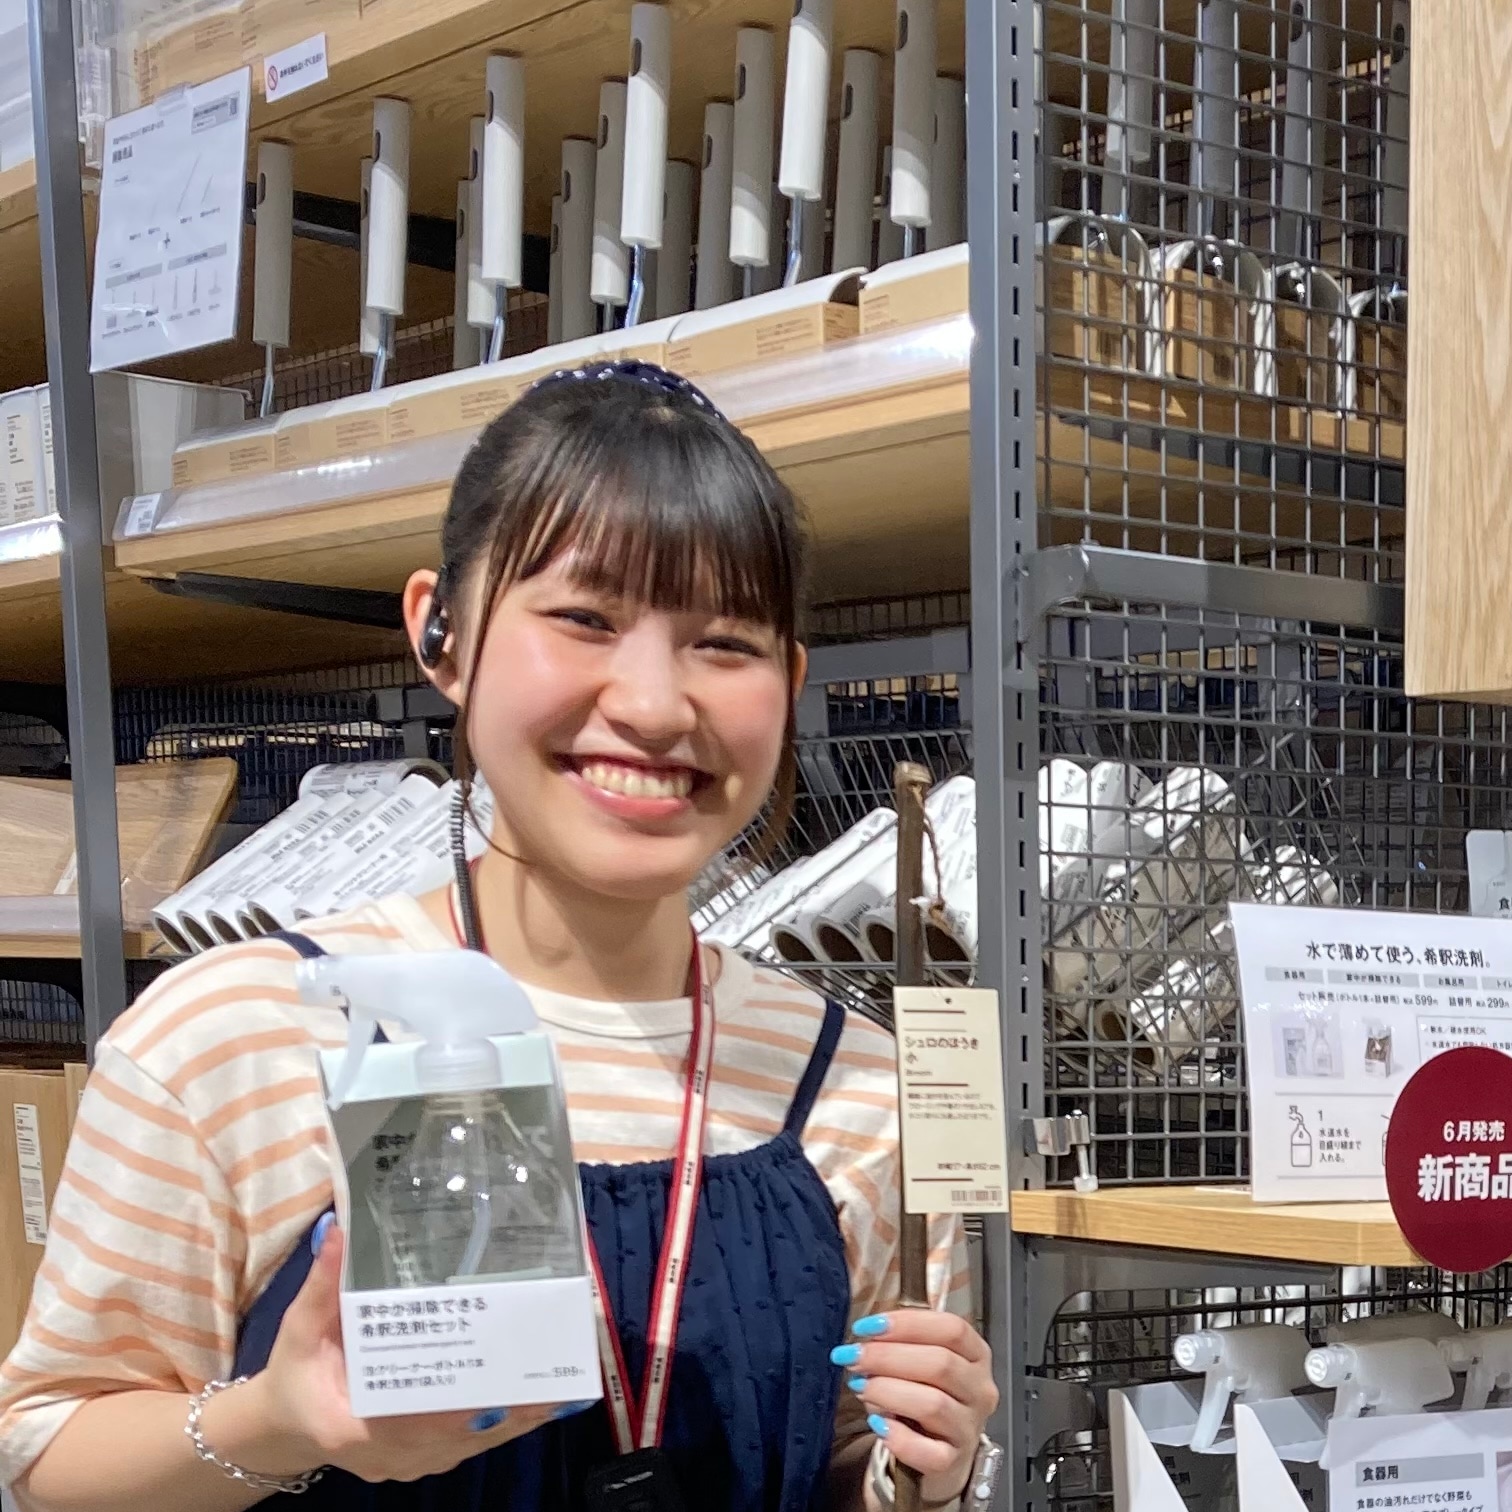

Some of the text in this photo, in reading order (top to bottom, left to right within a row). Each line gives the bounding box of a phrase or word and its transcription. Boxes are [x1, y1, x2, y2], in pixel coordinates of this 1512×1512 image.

[1444, 1120, 1505, 1142] 6月発売
[1363, 1465, 1398, 1481] 食器用
